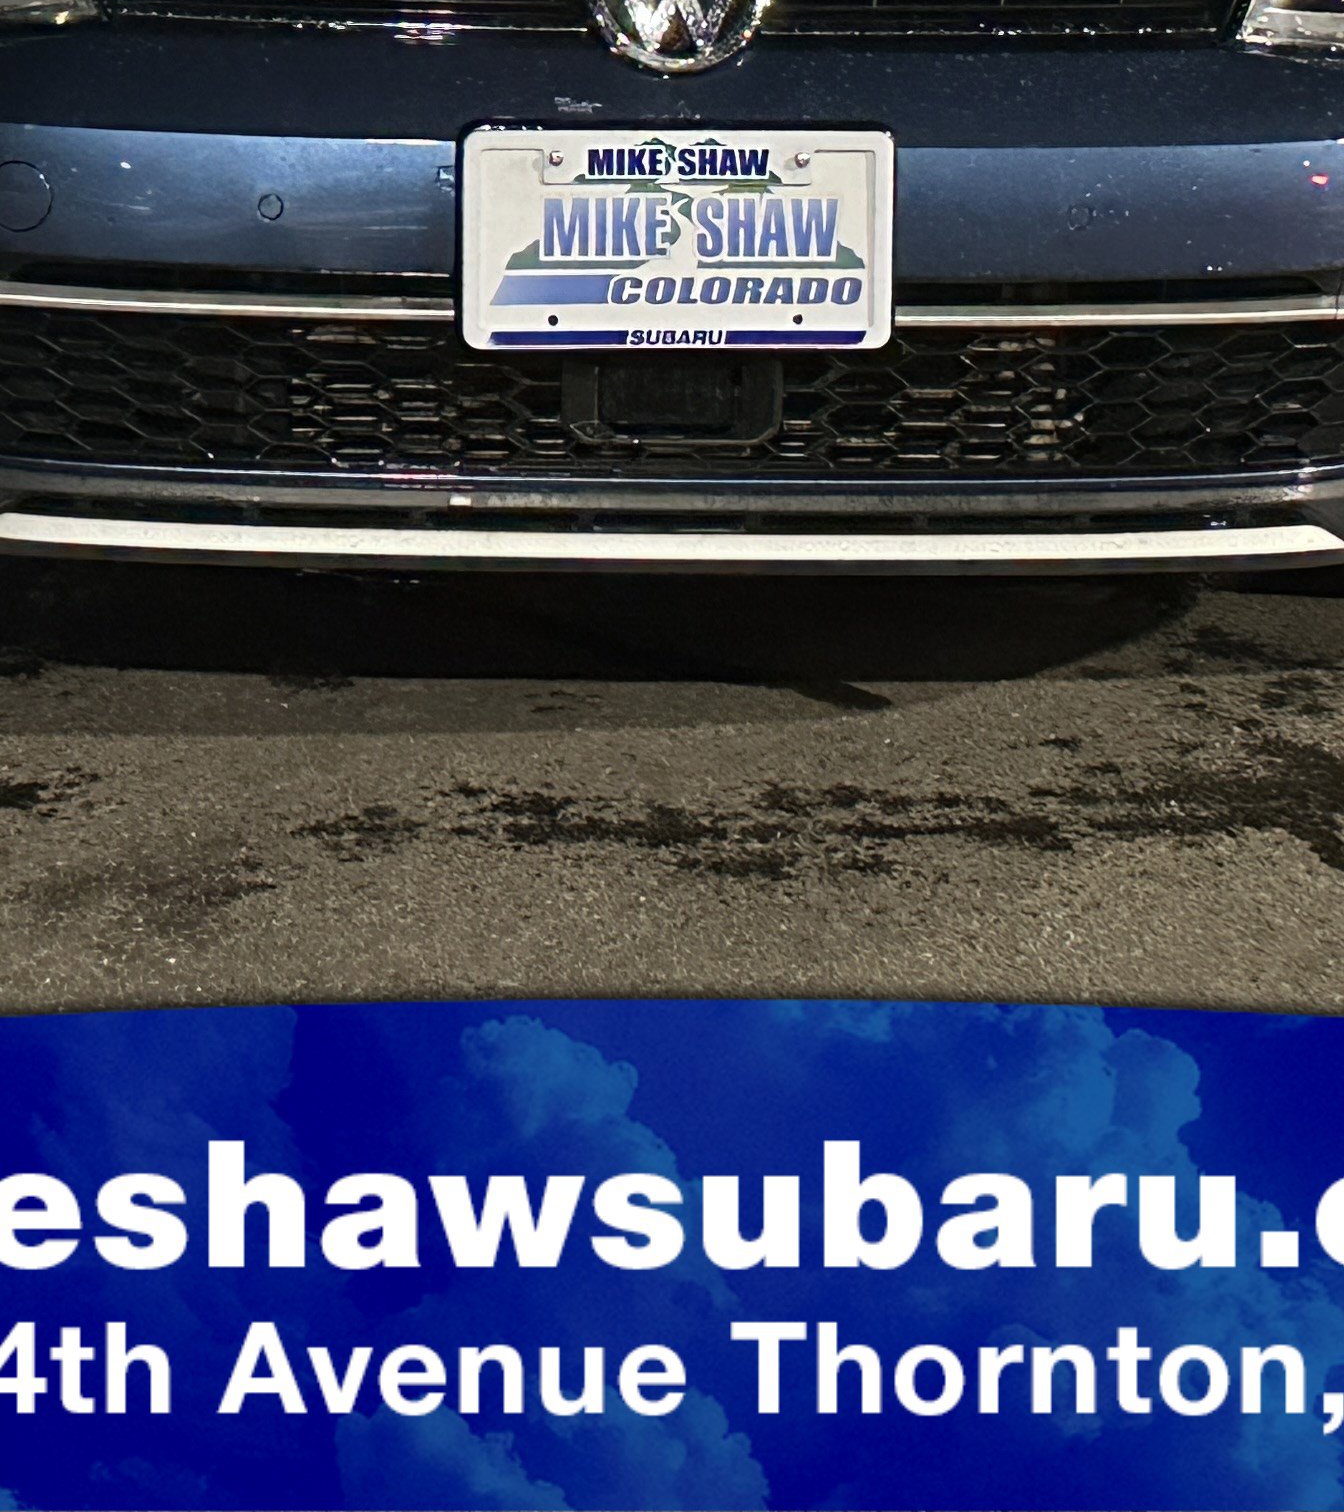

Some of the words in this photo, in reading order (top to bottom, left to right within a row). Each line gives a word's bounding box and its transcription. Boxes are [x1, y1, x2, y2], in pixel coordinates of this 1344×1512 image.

[587, 148, 666, 177] MIKE
[677, 148, 770, 177] SHAW
[542, 197, 669, 258] MIKE
[695, 197, 839, 259] SHAW
[609, 275, 863, 306] COLORADO
[628, 329, 724, 346] SUBARU
